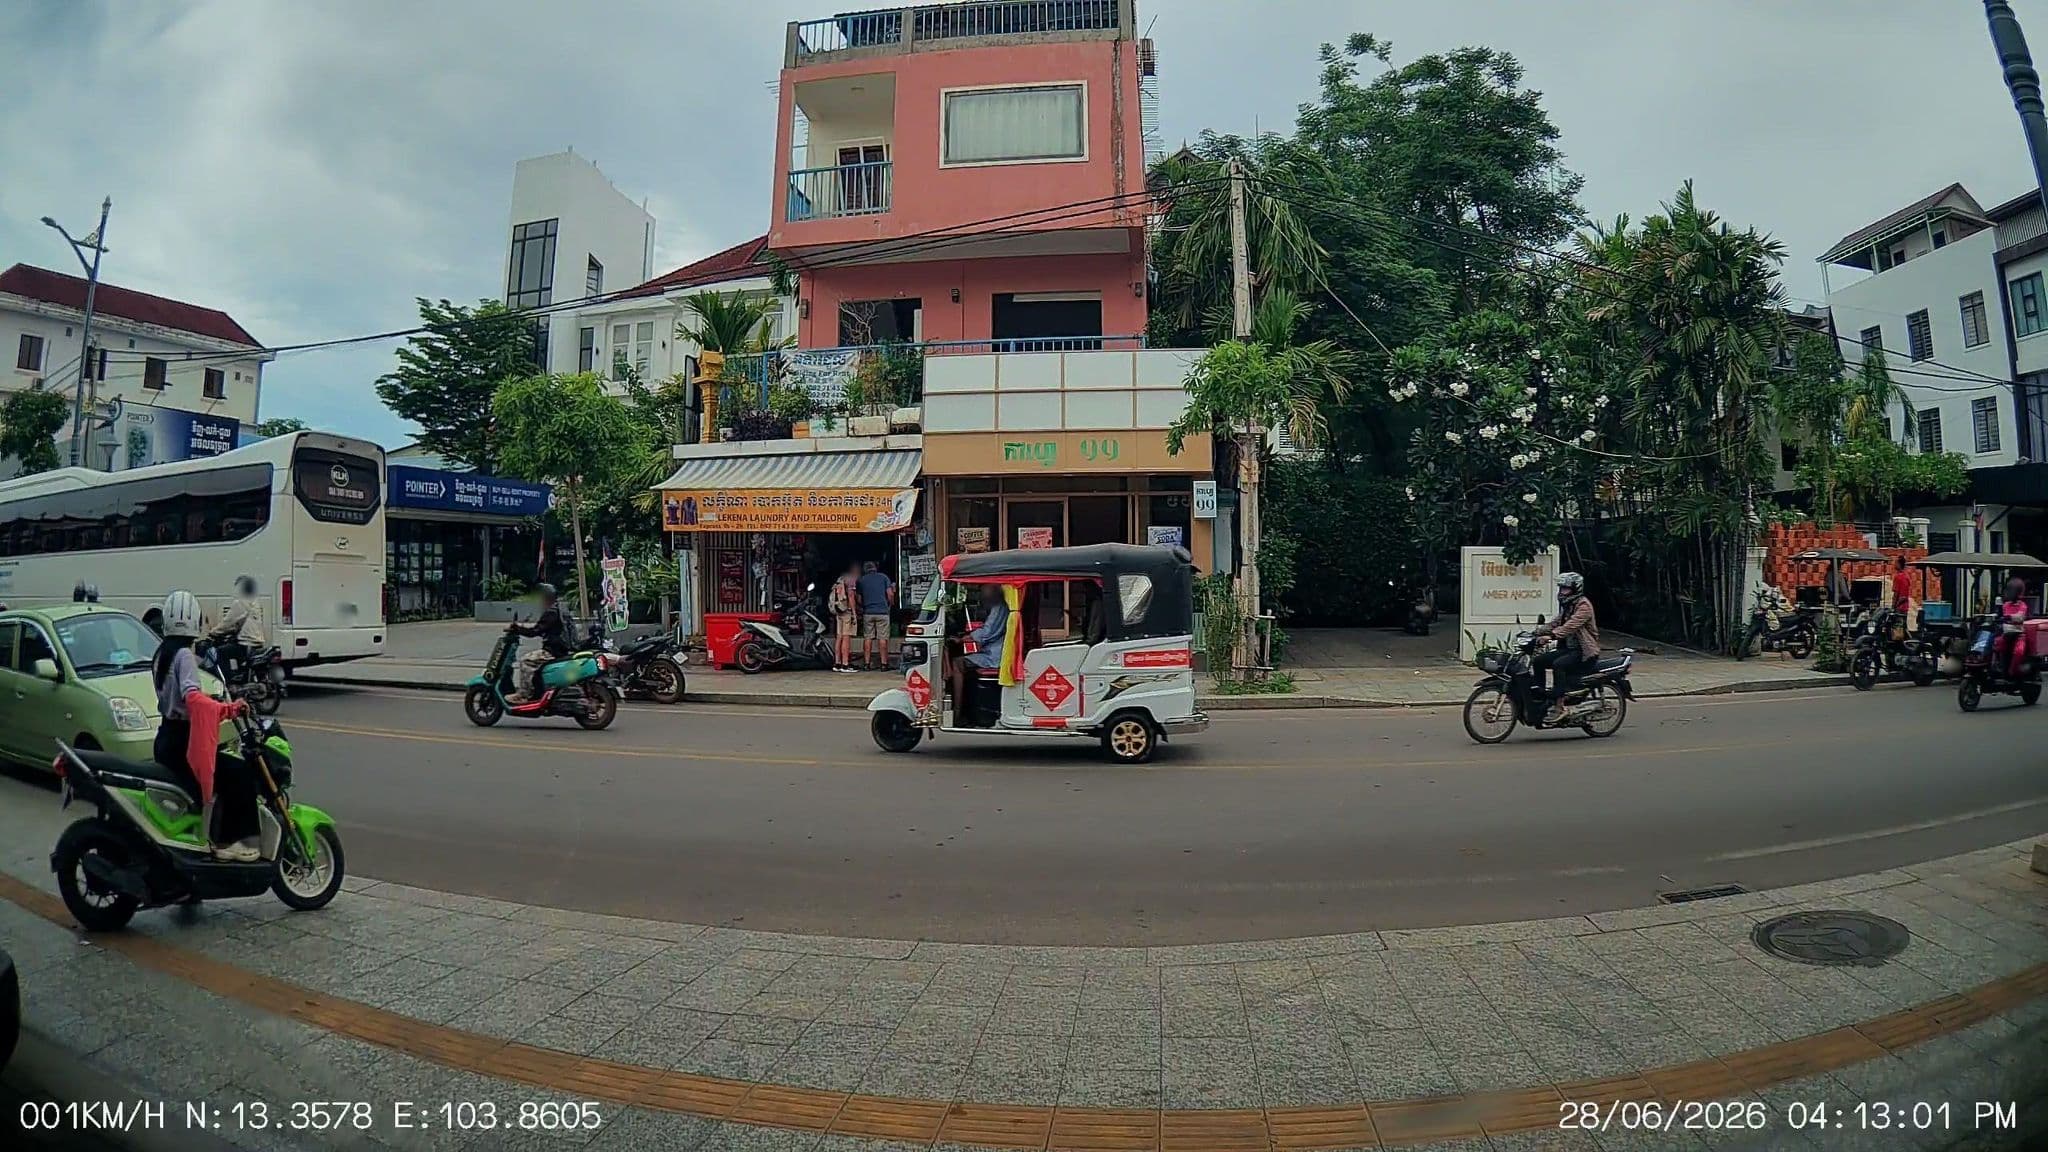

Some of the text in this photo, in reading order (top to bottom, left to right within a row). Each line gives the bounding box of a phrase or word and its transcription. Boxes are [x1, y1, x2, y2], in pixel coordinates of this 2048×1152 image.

[1080, 439, 1119, 461] 99
[405, 480, 439, 494] POINTER
[1196, 499, 1215, 511] 99
[717, 514, 857, 522] LEKENA LAUNDRY AND TAILORING
[1481, 589, 1542, 600] AMBER ANGKOR
